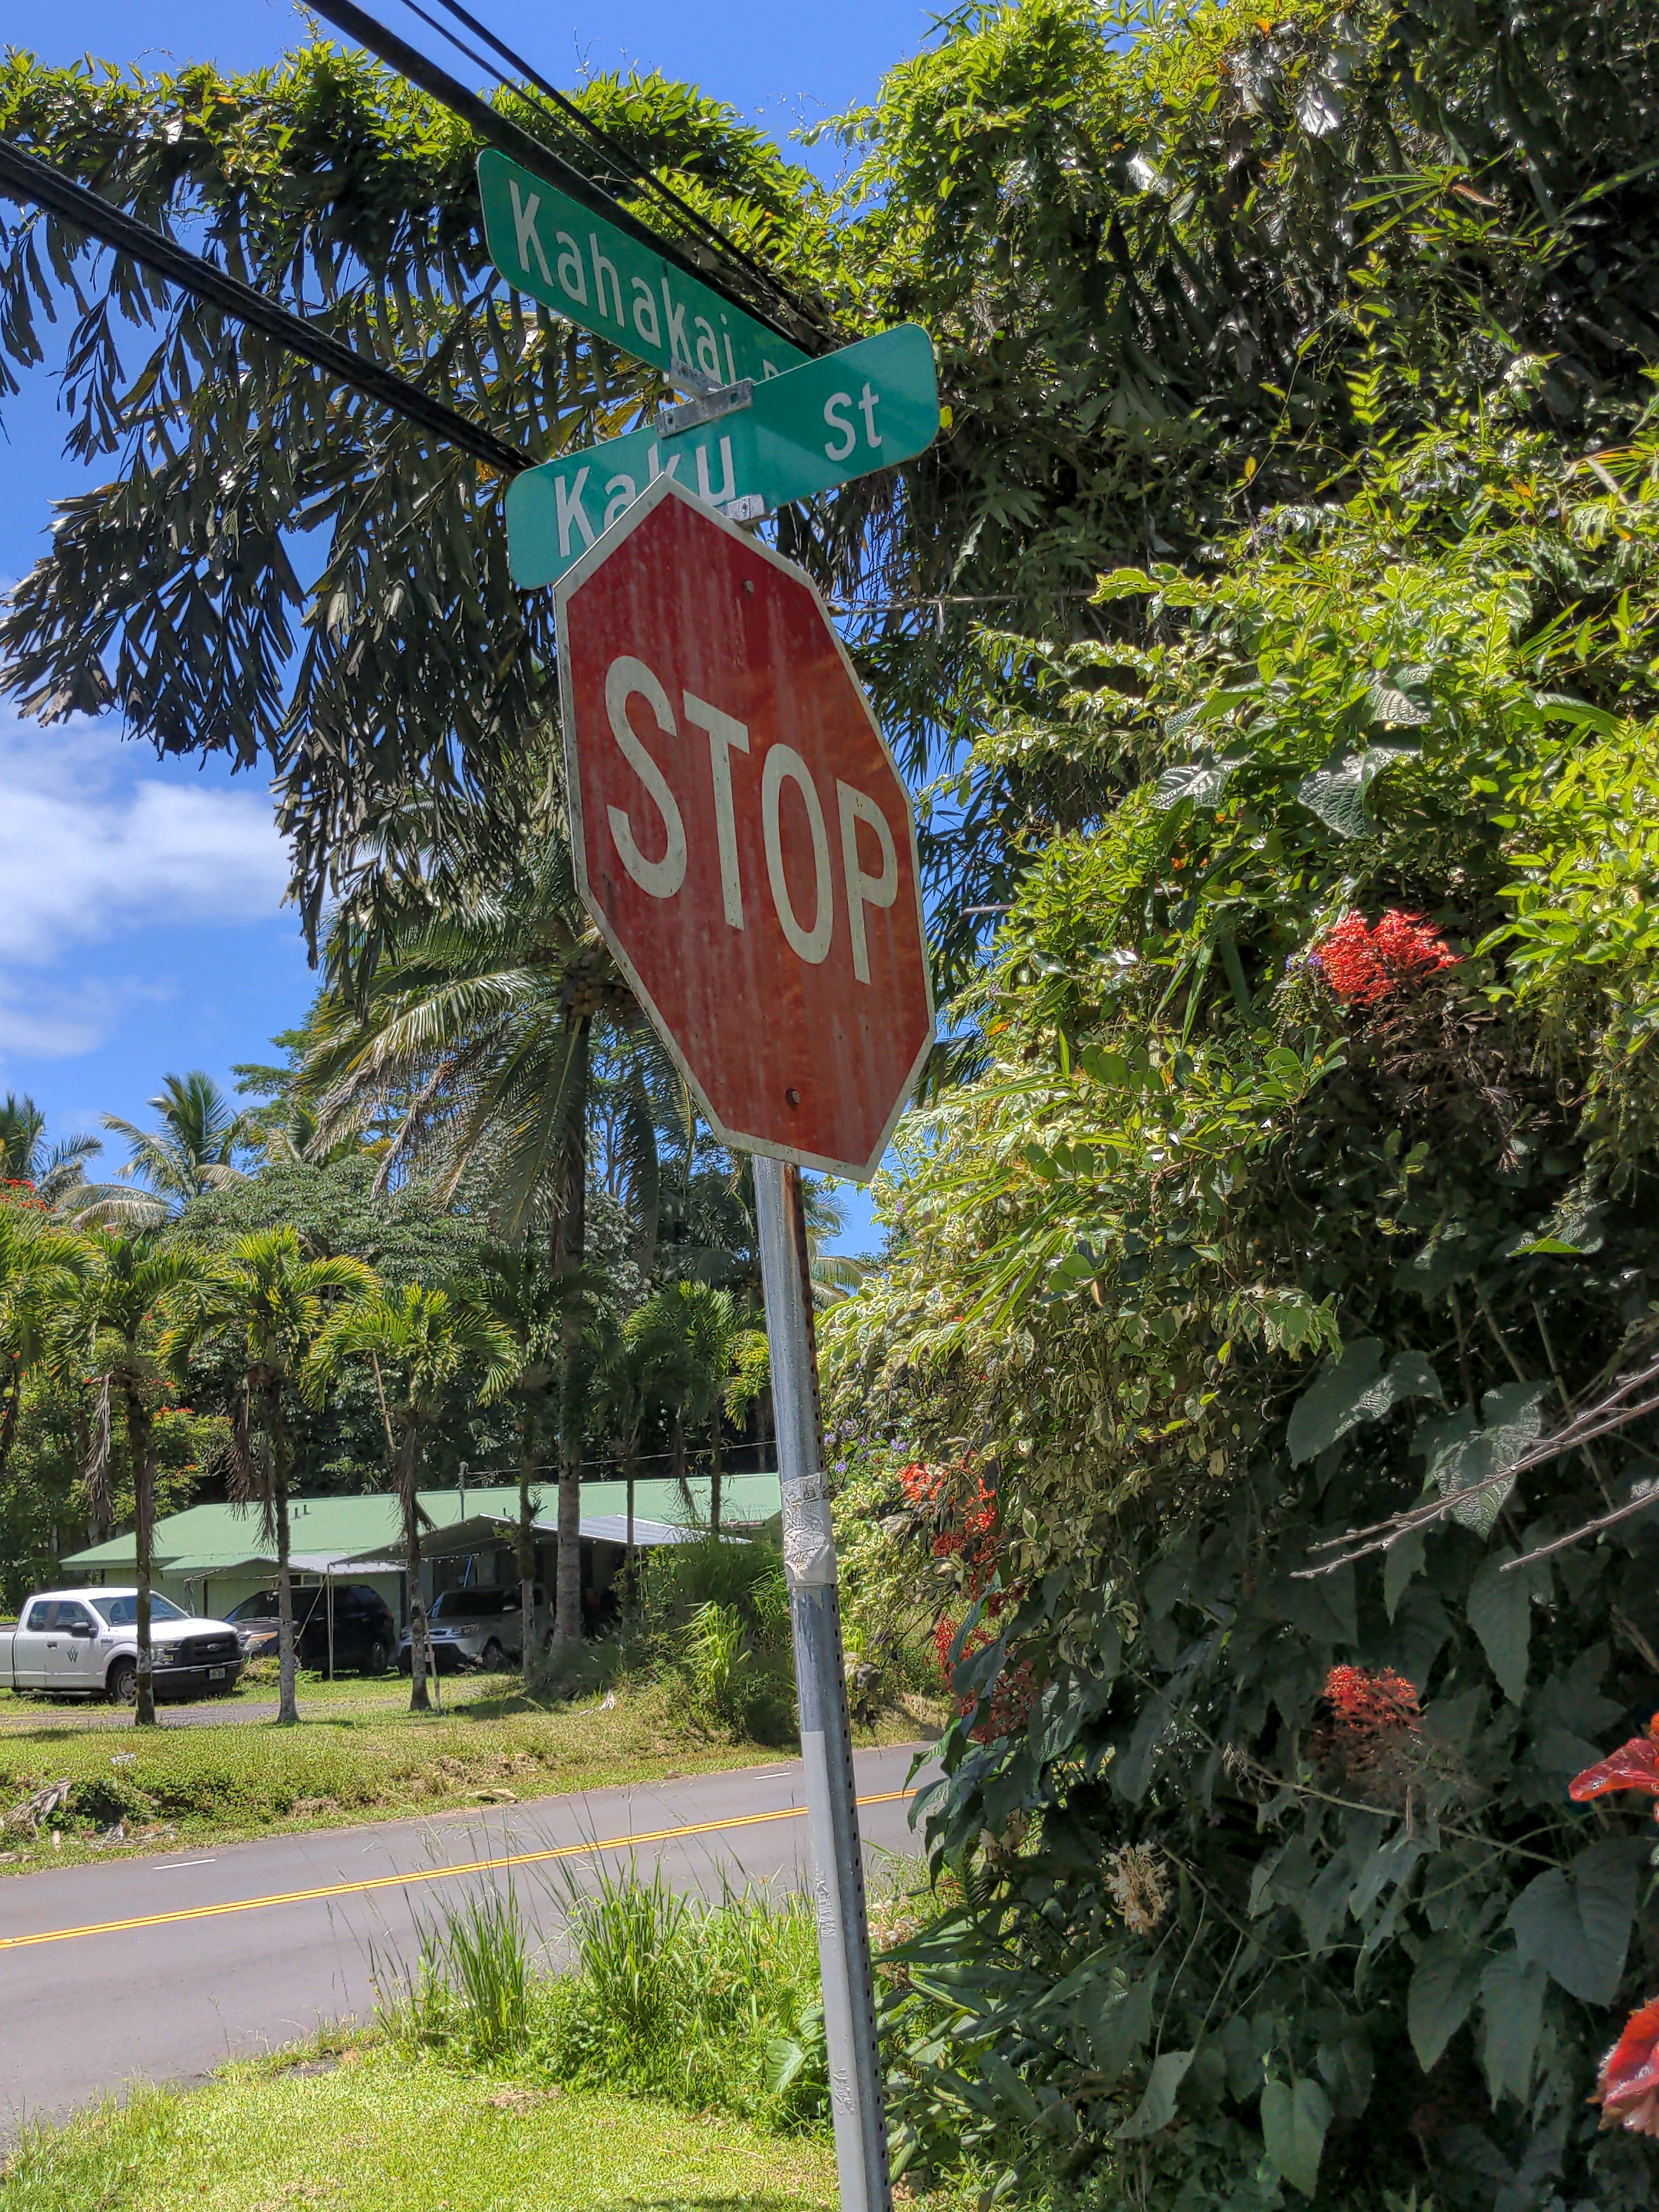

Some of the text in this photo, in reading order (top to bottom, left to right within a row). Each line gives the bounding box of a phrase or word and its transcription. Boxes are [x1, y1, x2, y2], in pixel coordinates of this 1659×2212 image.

[509, 178, 737, 385] Kahakai
[823, 382, 882, 461] St
[605, 655, 898, 985] STOP
